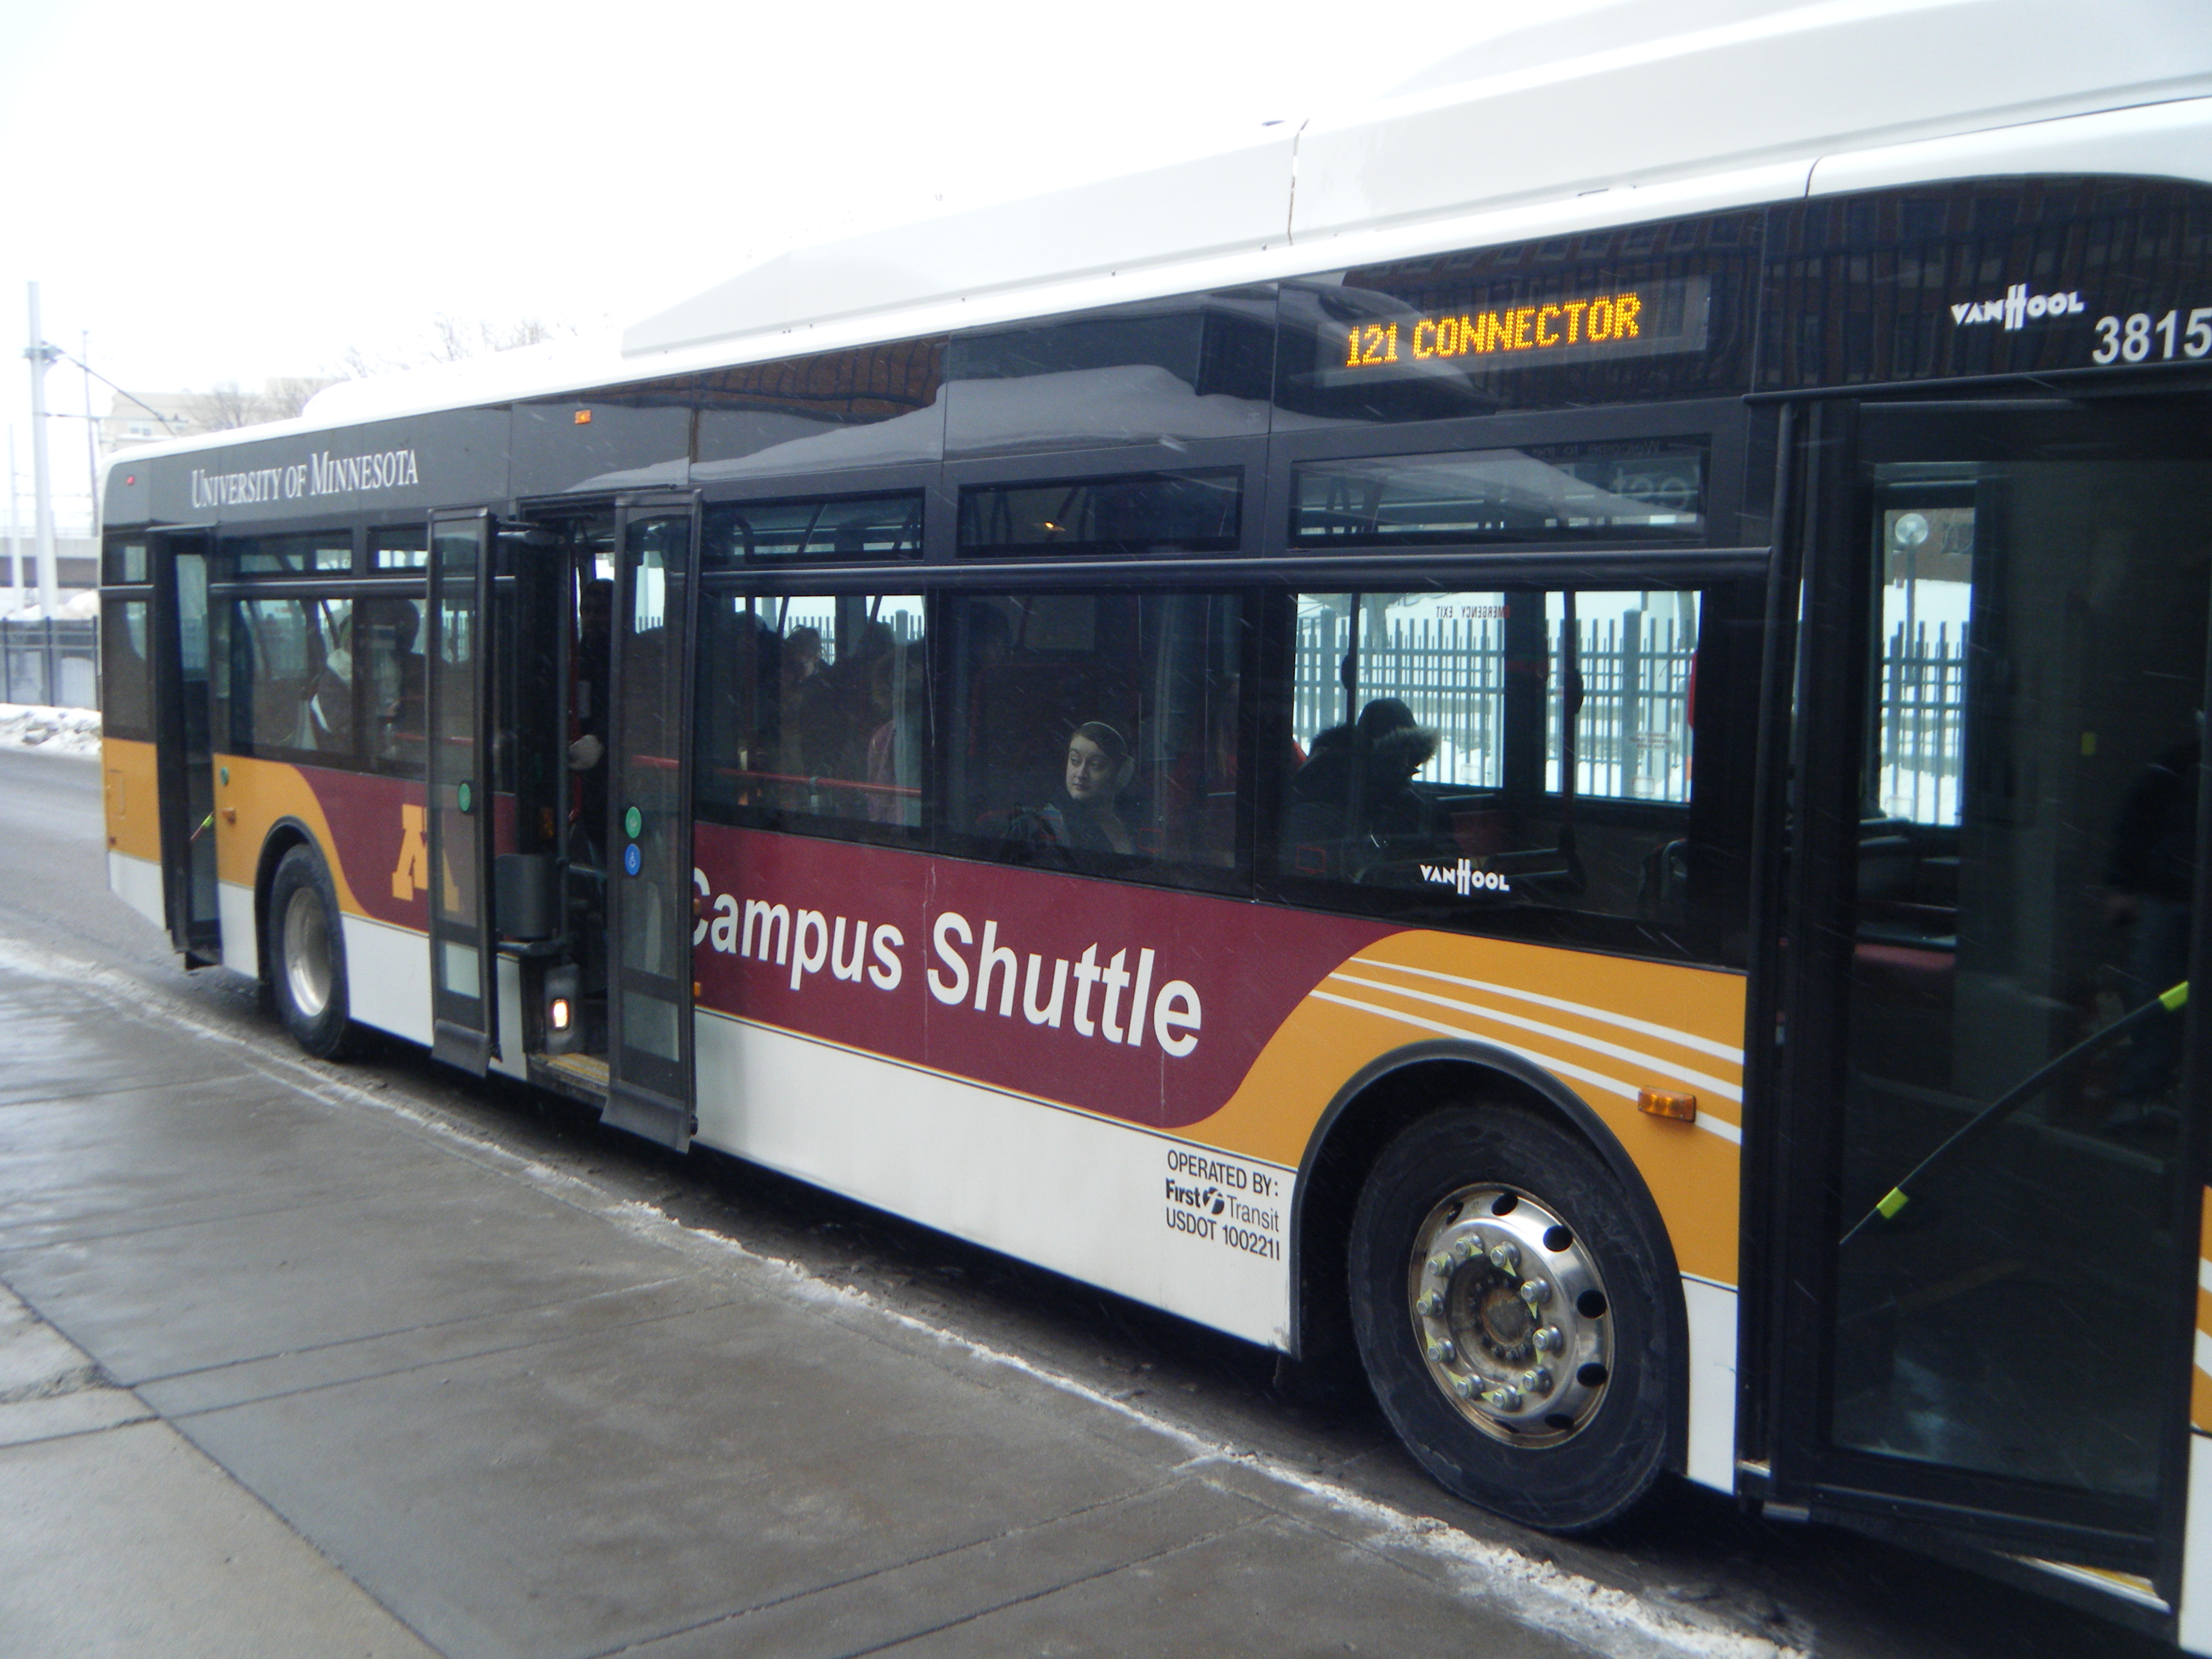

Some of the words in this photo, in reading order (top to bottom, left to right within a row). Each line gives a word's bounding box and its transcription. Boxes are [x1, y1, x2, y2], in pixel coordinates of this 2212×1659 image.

[1346, 321, 1398, 367] 121
[1412, 291, 1641, 360] CONNECTOR
[2092, 307, 2212, 364] 3815
[191, 468, 282, 508] UNIVERSITY
[285, 464, 307, 499] OF
[310, 449, 418, 496] MINNESOTA
[927, 911, 1202, 1059] Shuttle
[1167, 1149, 1247, 1190] OPERATED
[1252, 1171, 1279, 1197] BY:
[1165, 1177, 1201, 1208] First
[1226, 1193, 1279, 1233] Transit
[1166, 1206, 1218, 1241] USDOT
